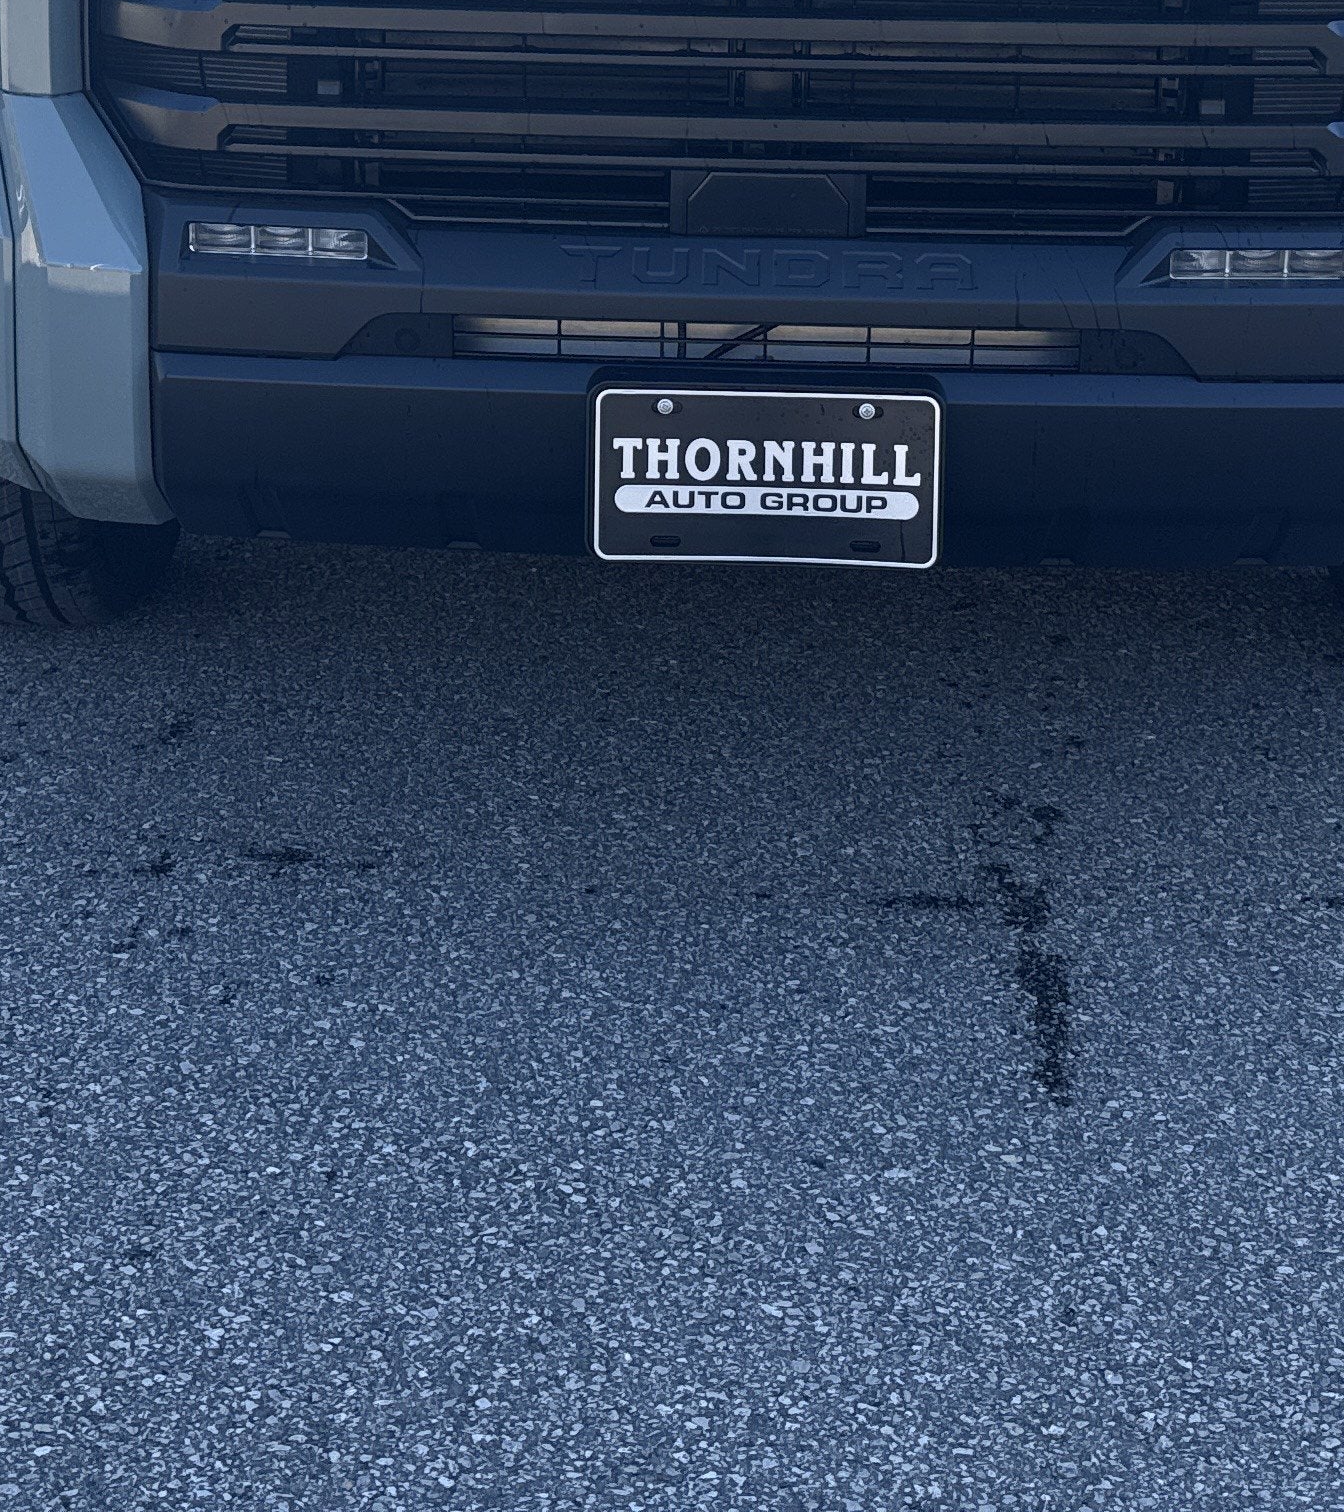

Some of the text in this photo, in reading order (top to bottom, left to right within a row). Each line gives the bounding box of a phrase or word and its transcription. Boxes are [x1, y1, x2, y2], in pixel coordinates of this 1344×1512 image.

[559, 244, 980, 291] TUNDRA
[612, 438, 921, 487] THORNHILL
[644, 489, 889, 515] AUTO GROUP
